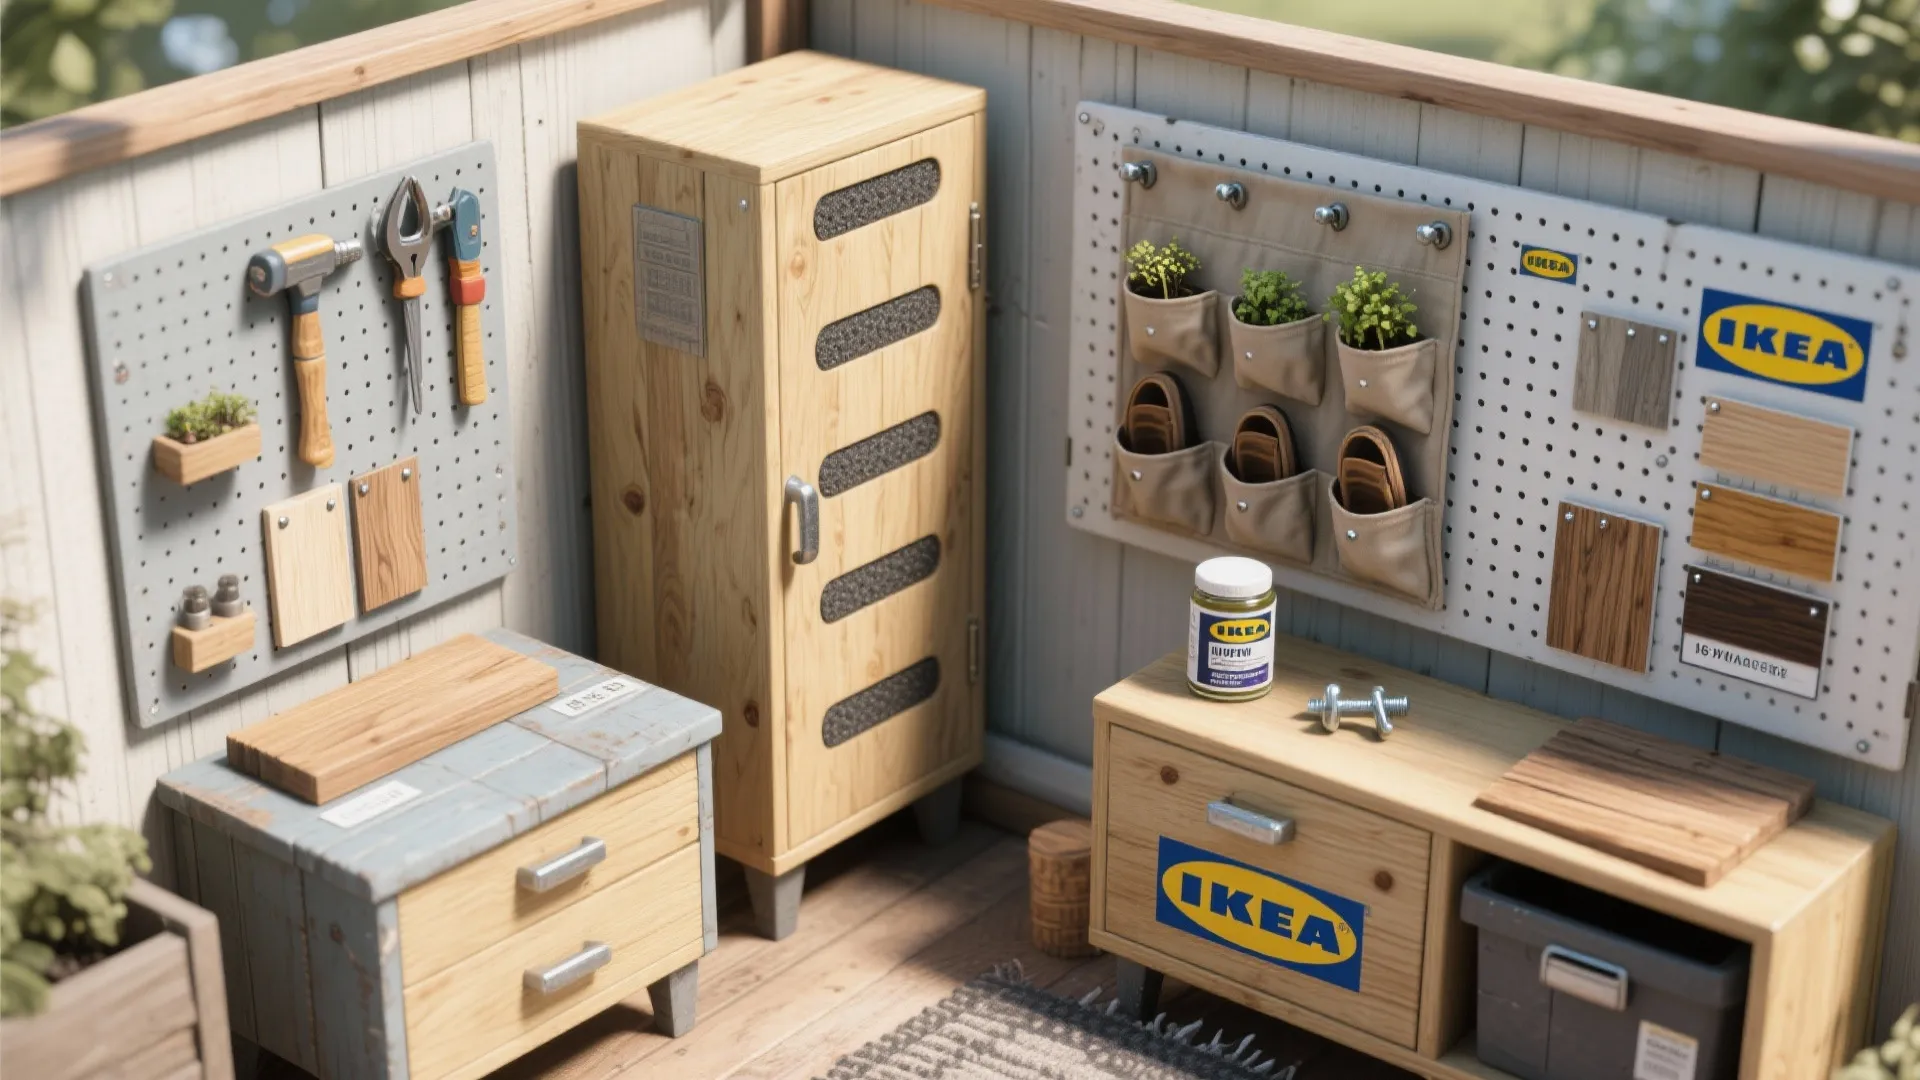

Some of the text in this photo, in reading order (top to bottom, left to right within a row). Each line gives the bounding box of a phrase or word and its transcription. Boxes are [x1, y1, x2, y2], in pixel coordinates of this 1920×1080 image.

[1717, 317, 1849, 371] IKEA
[1217, 624, 1266, 637] IKEA
[1180, 871, 1341, 956] IKEA
